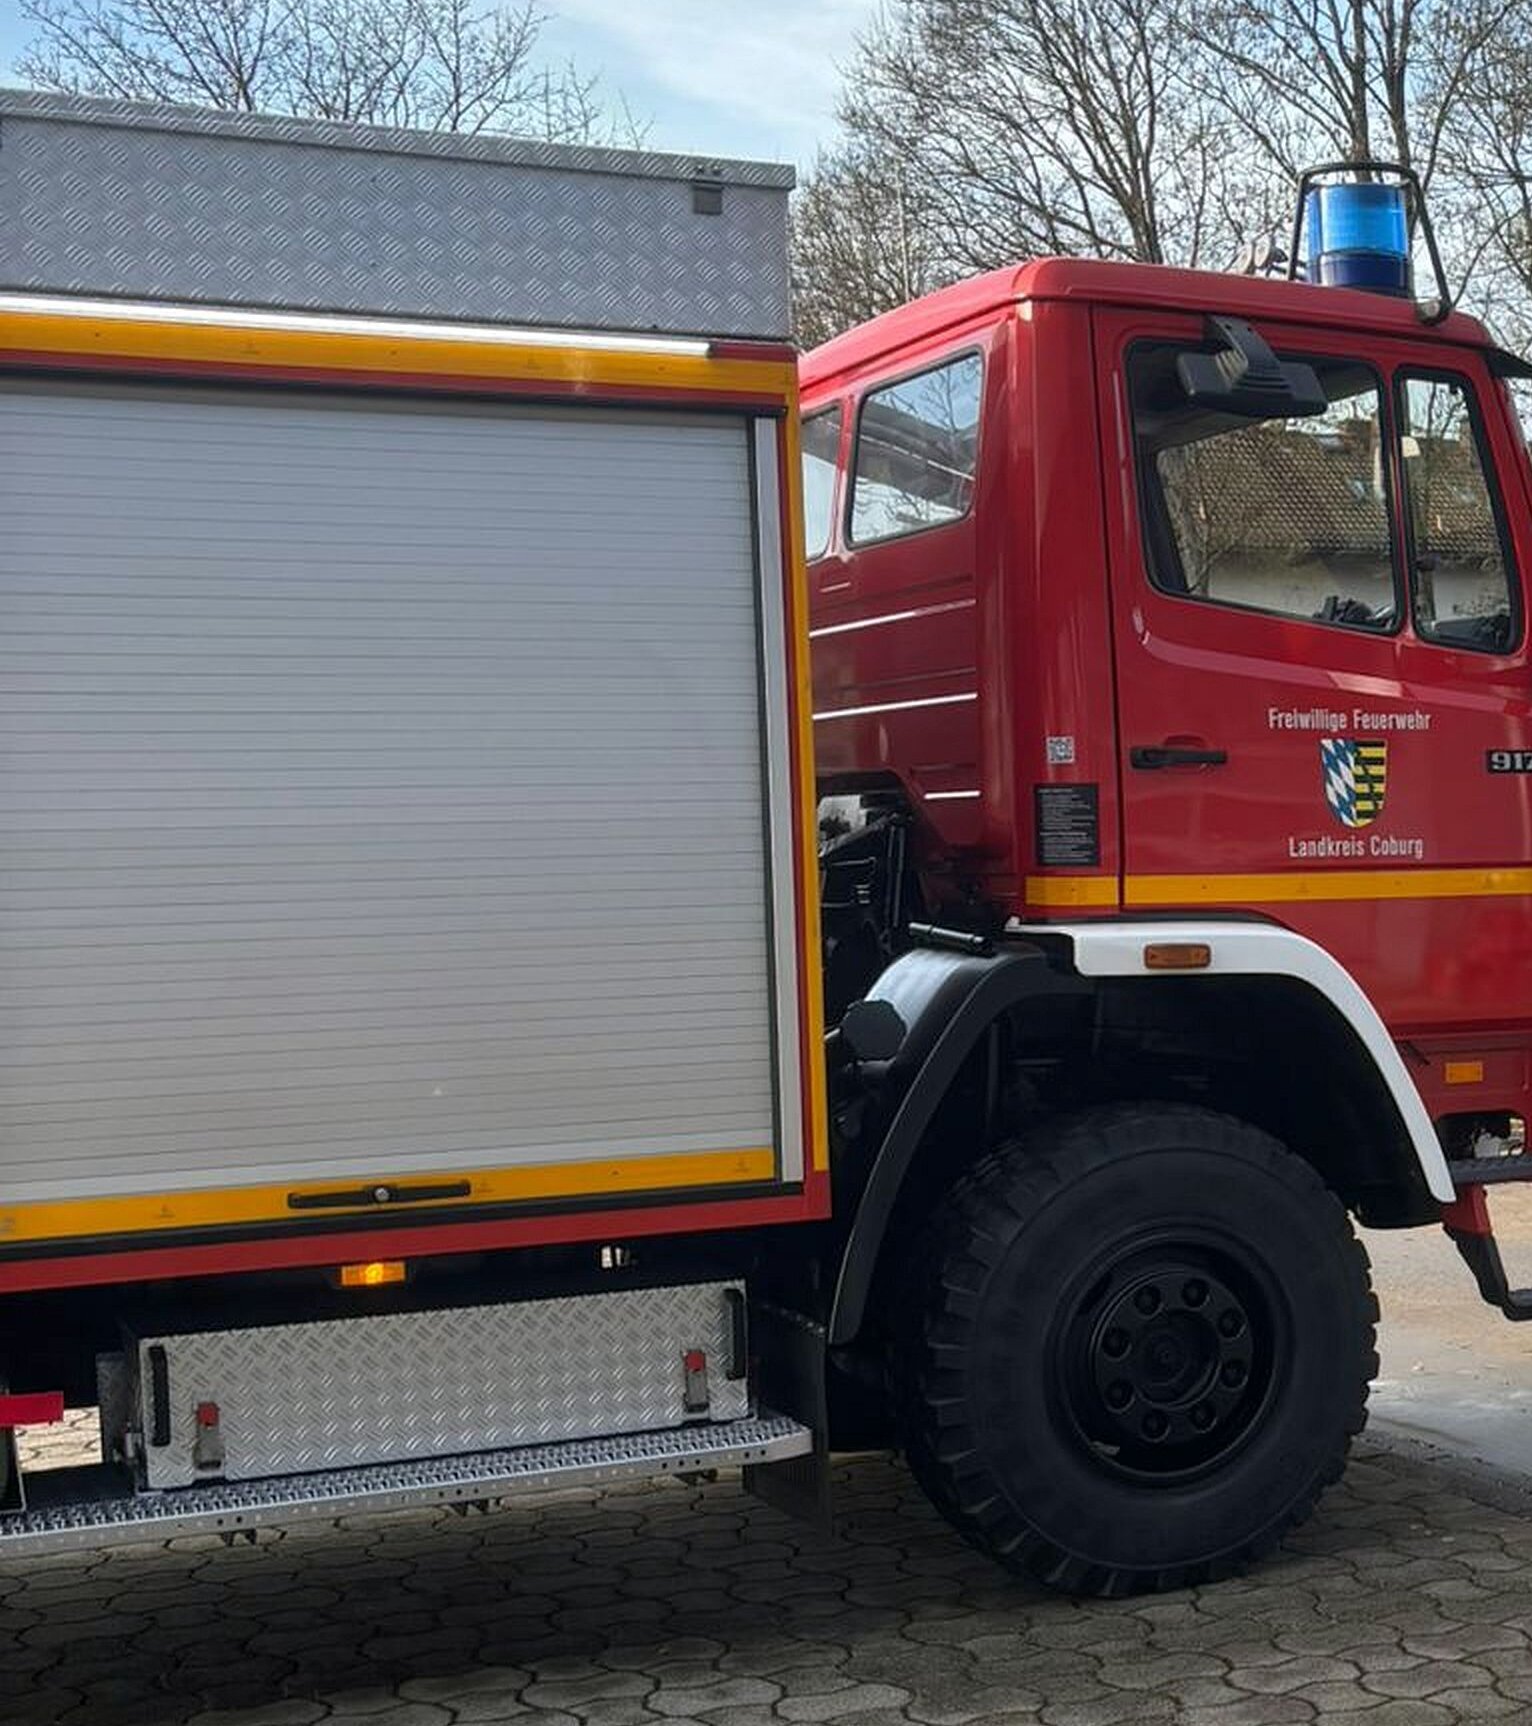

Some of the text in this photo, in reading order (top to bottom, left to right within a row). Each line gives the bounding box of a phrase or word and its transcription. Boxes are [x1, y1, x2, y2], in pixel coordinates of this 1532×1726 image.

[1268, 707, 1431, 732] Freiwillige Feuerwehr
[1288, 835, 1424, 859] Landkreis Coburg
